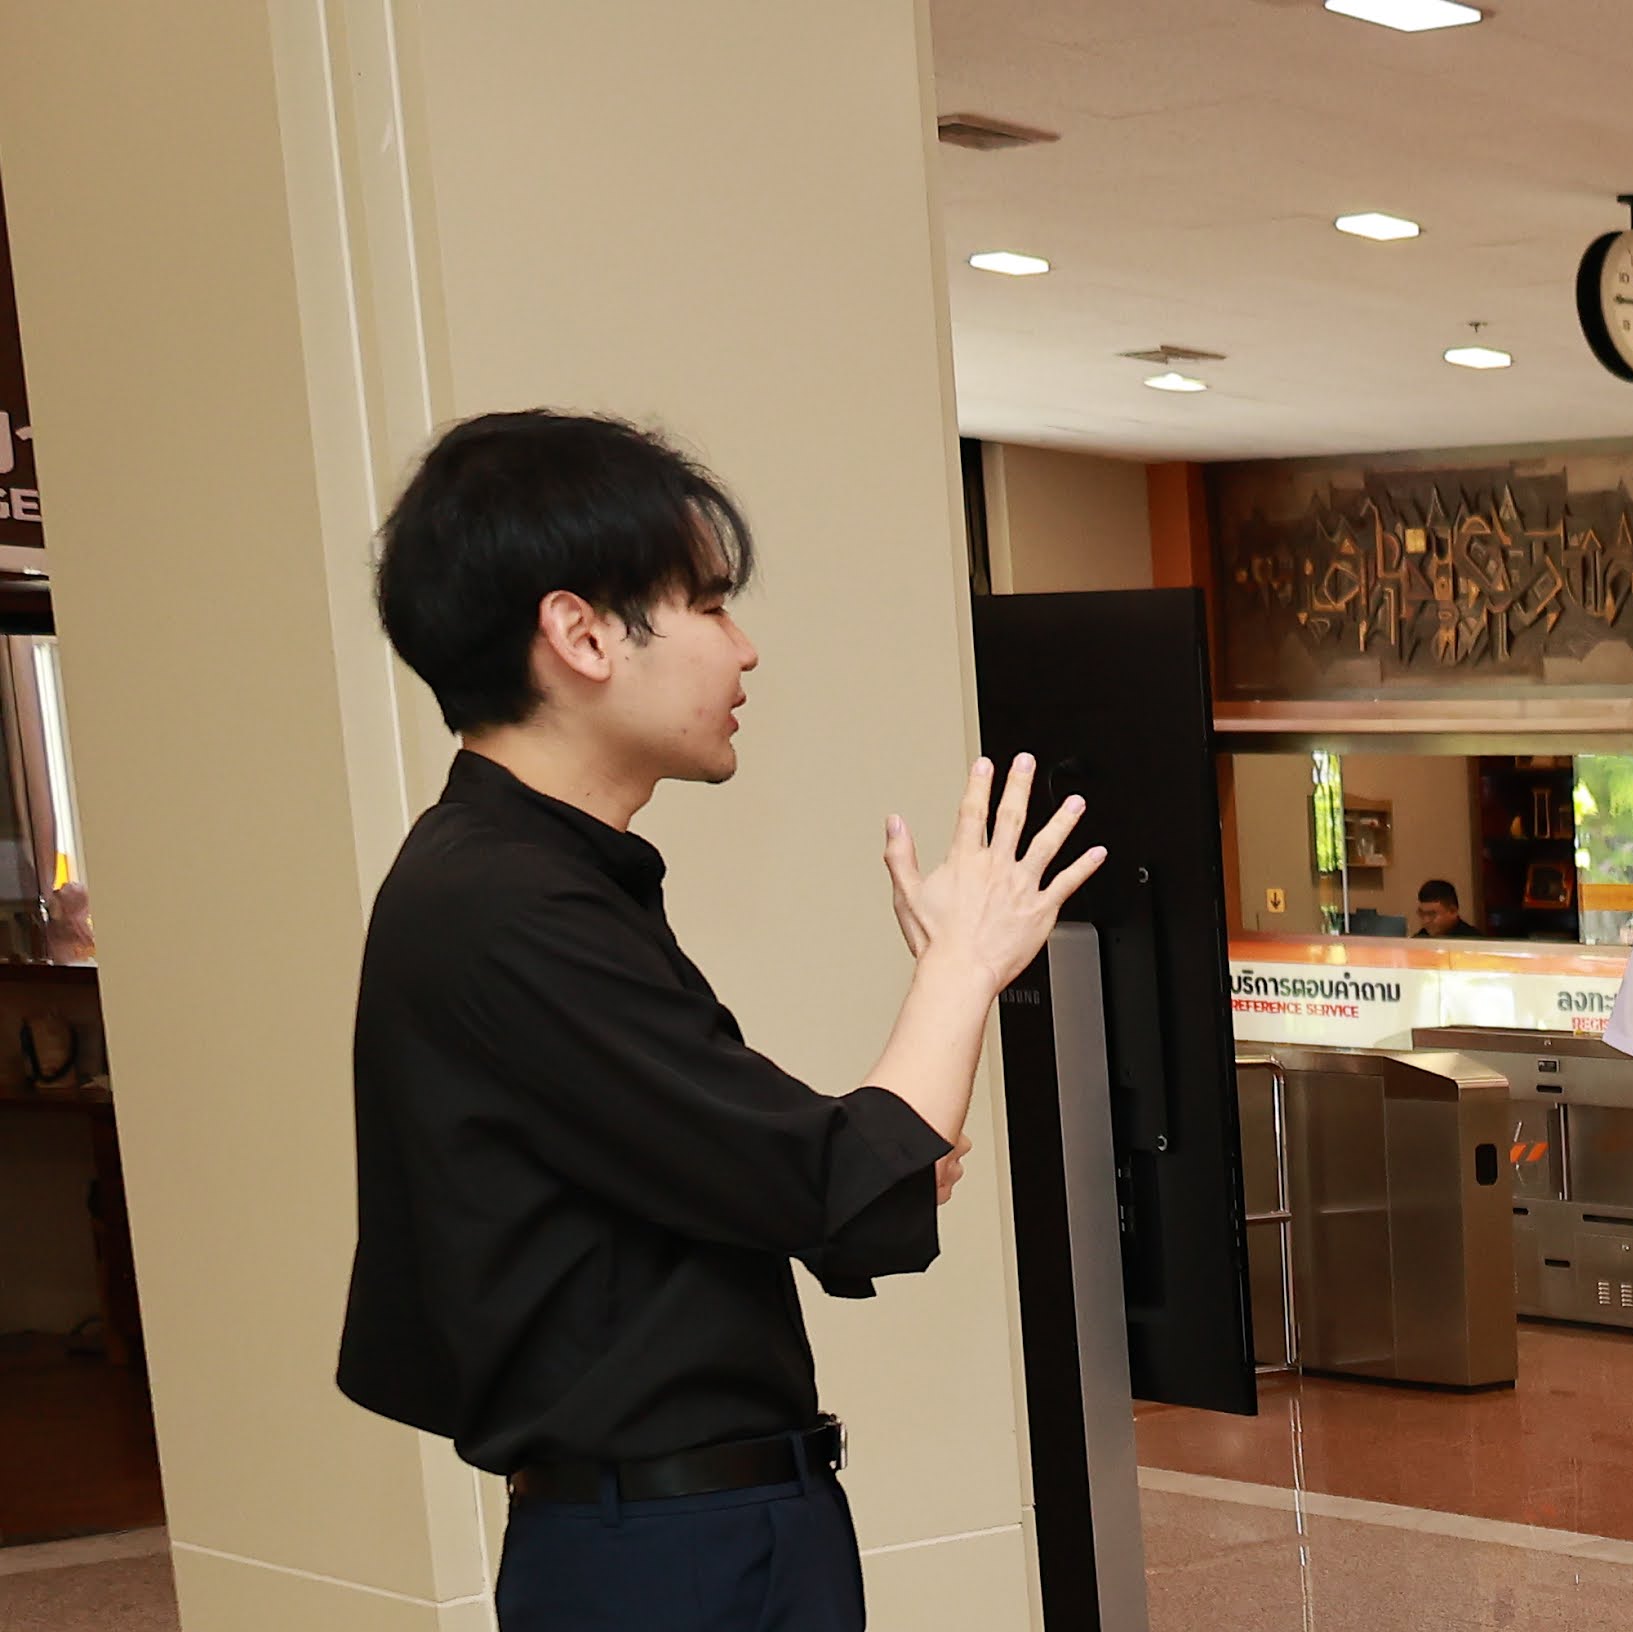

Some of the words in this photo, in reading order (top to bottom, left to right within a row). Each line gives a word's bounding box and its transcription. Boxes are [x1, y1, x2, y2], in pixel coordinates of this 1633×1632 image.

[1231, 969, 1400, 1003] บริการตอบคำถาม
[1231, 999, 1302, 1016] REFERENCE
[1306, 1003, 1360, 1019] SERVICE
